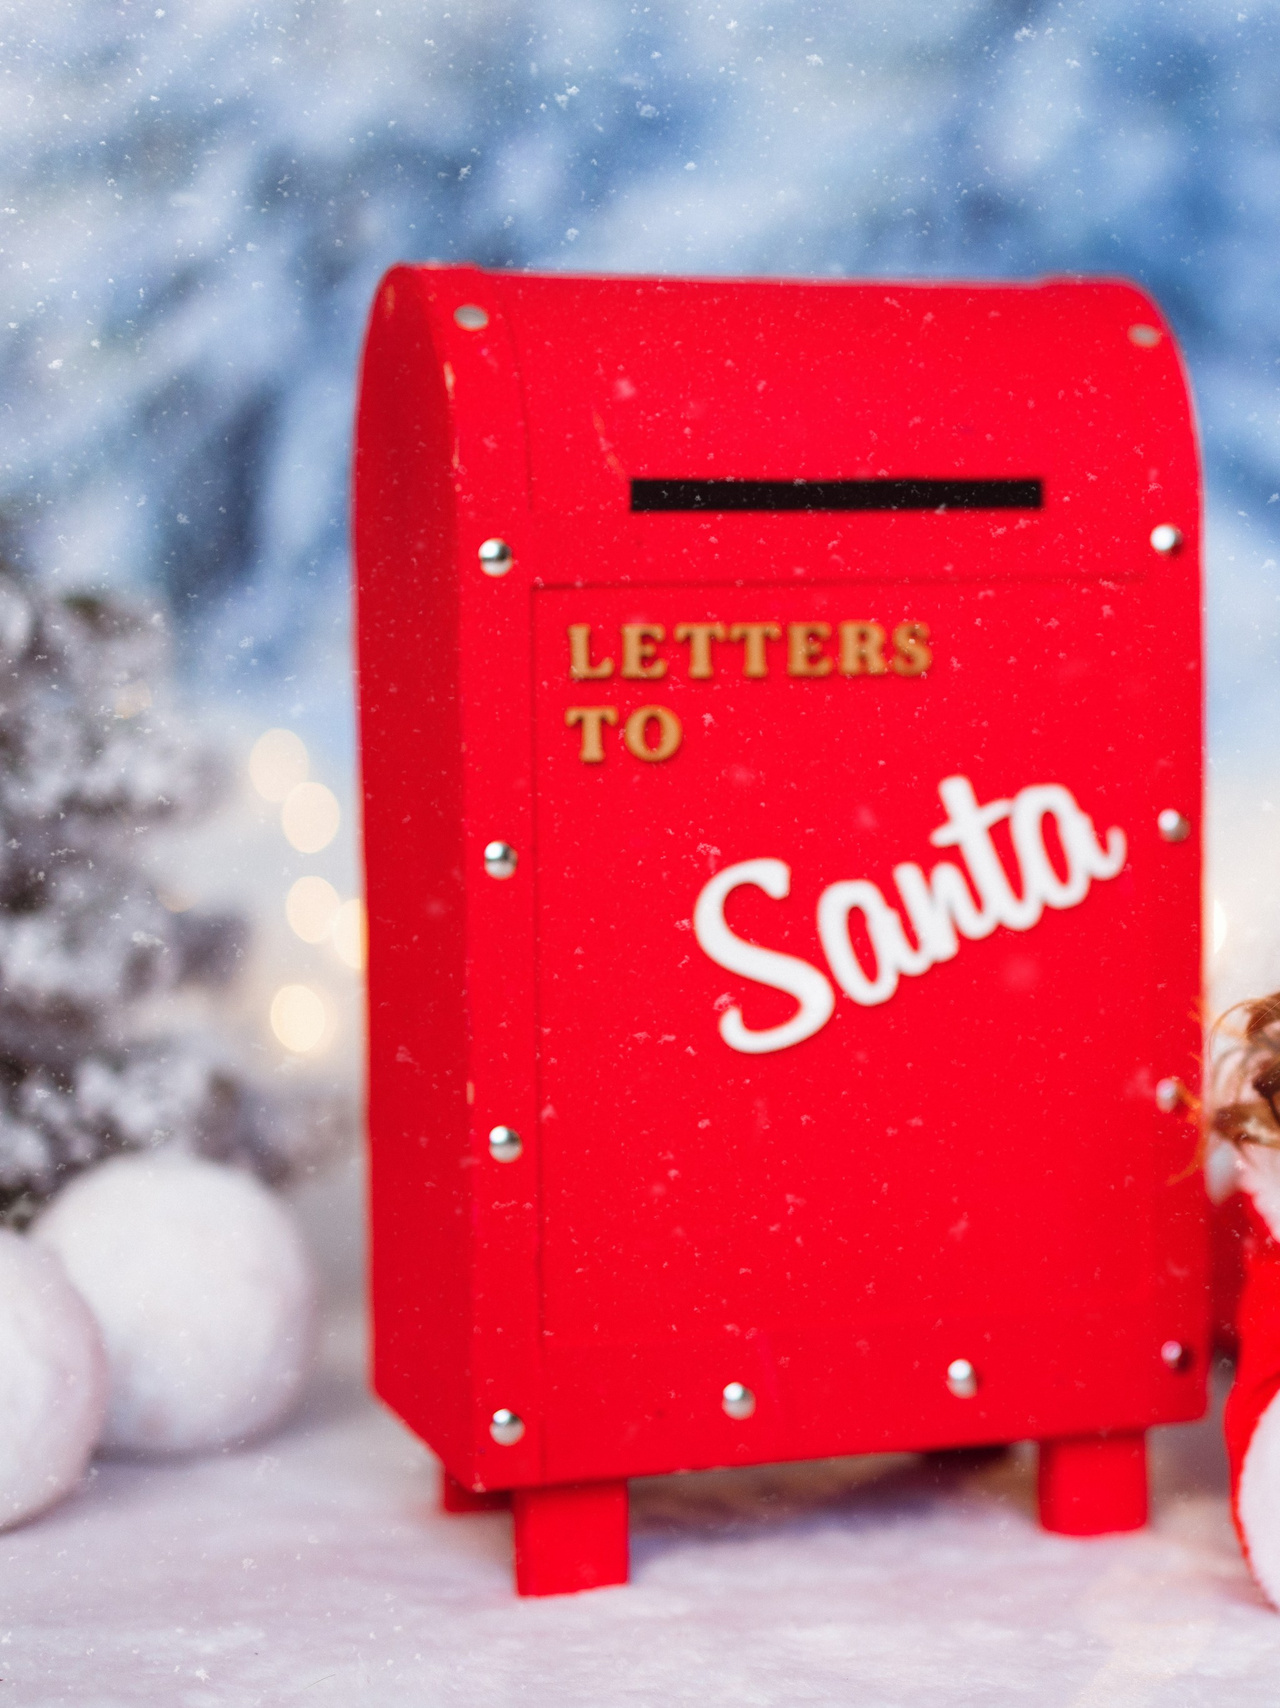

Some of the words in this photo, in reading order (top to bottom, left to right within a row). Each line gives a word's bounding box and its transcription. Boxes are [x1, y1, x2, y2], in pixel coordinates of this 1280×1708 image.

[567, 620, 932, 679] LETTERS
[565, 705, 682, 763] TO
[693, 774, 1127, 1054] Santa
